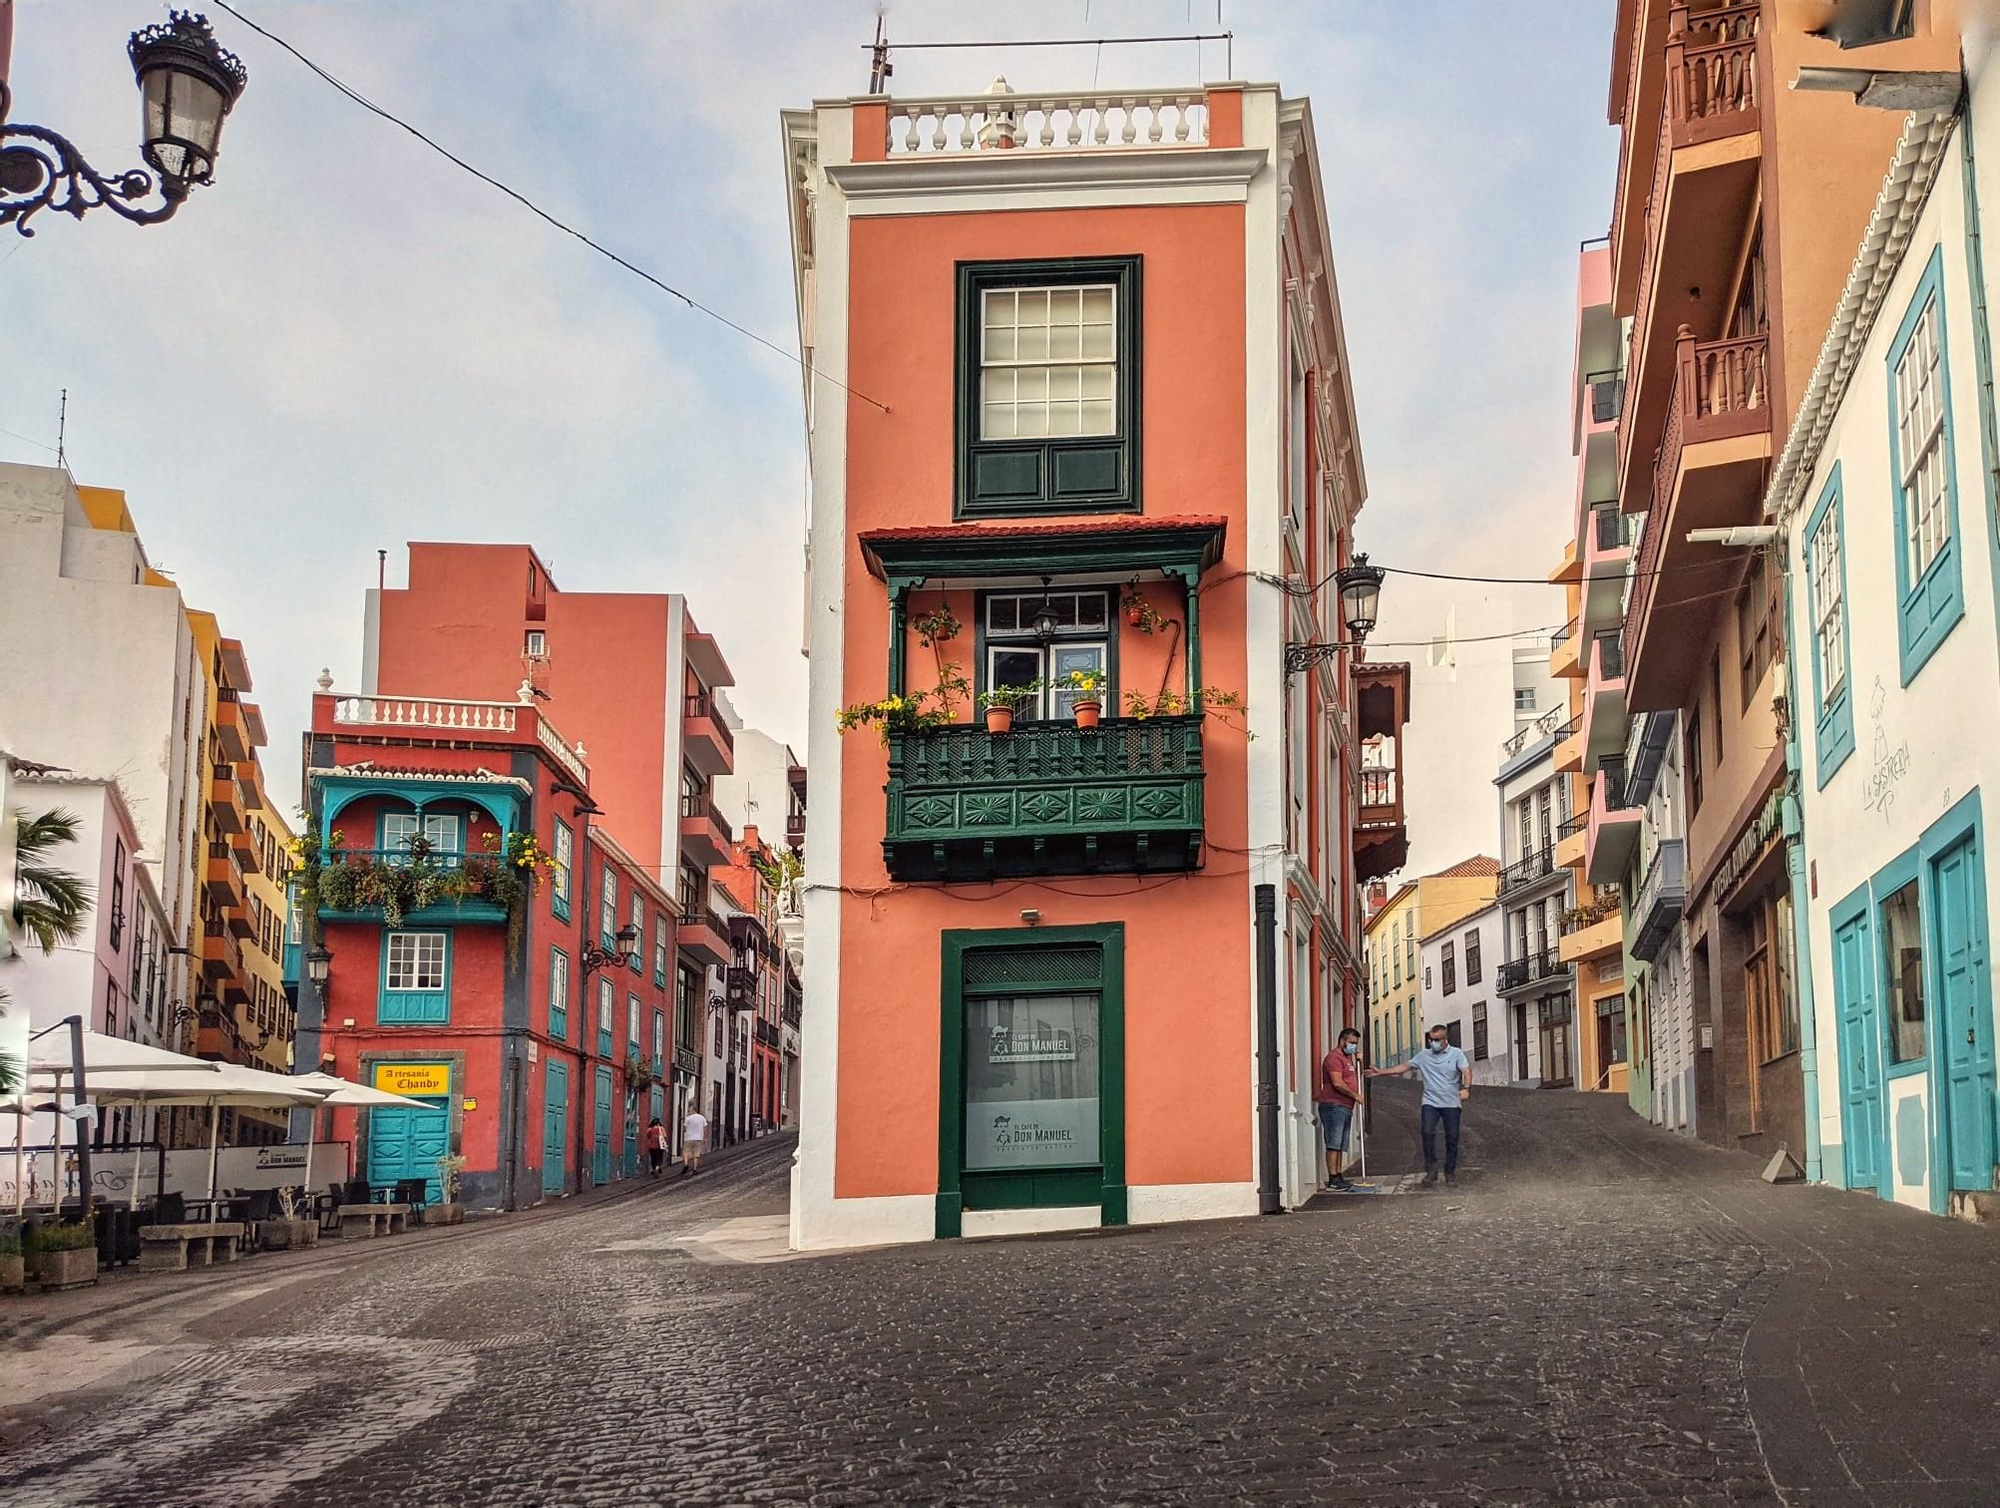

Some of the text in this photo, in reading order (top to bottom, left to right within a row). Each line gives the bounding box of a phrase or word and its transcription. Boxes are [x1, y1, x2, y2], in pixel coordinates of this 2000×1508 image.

[1012, 1039, 1069, 1052] DON MANUEL
[397, 1079, 440, 1090] Chandy
[1014, 1130, 1072, 1143] DON MANUEL
